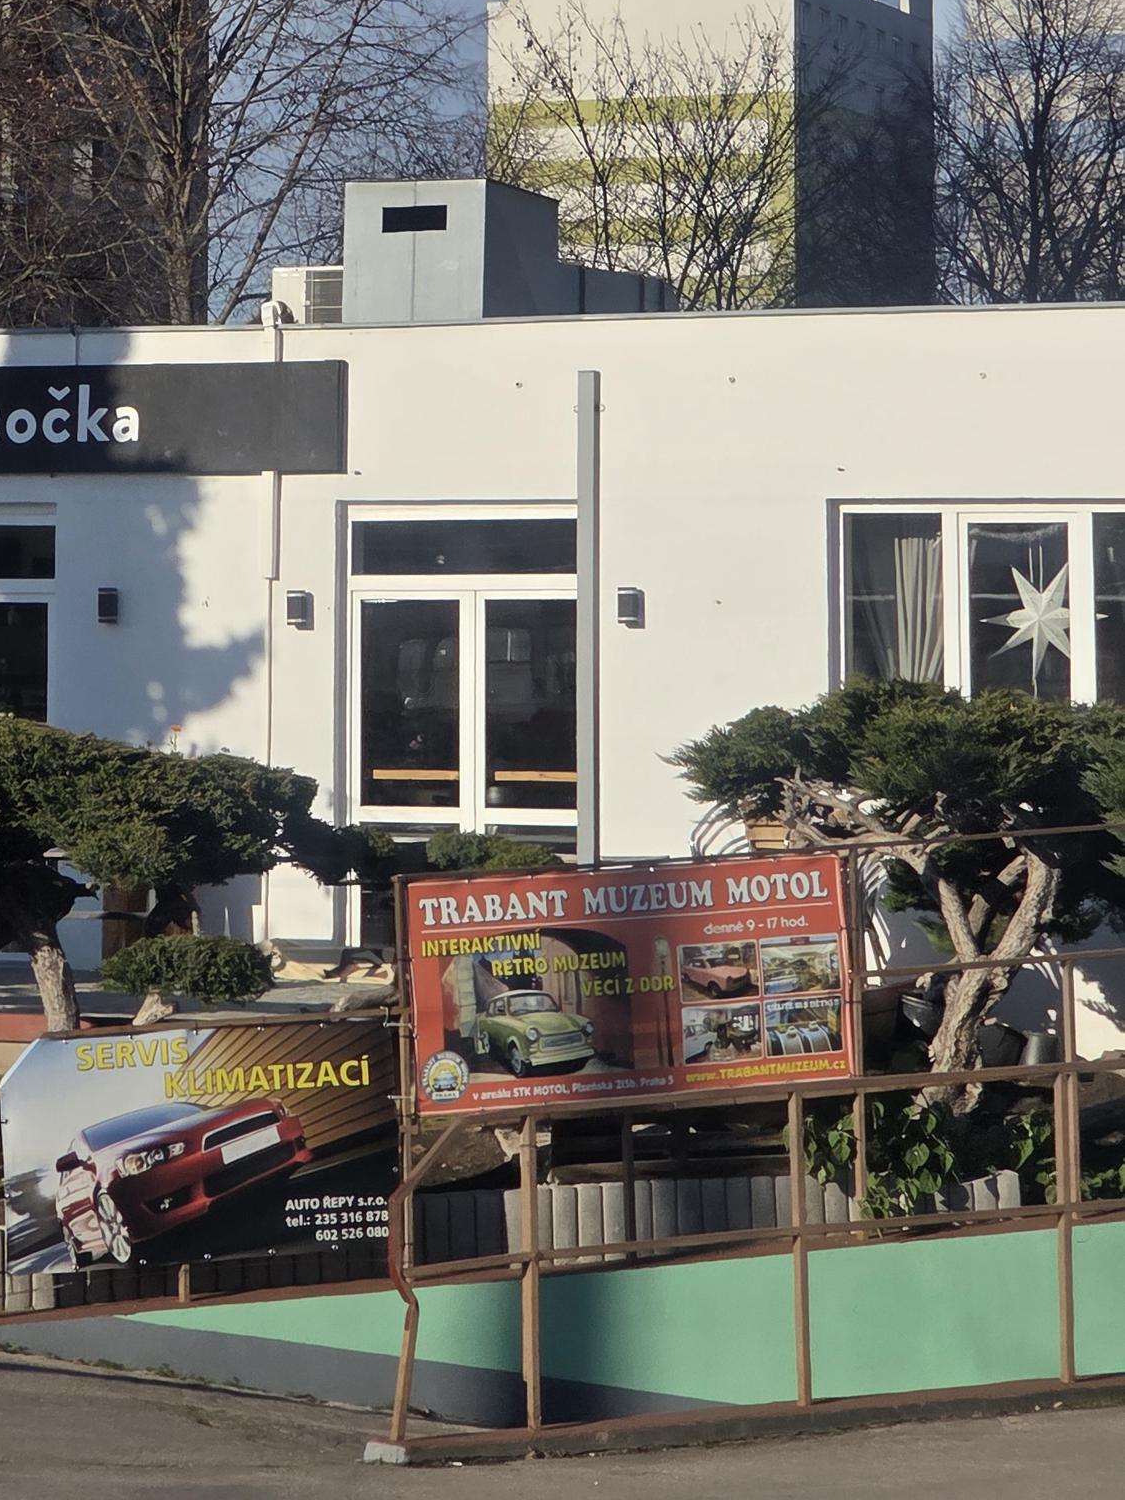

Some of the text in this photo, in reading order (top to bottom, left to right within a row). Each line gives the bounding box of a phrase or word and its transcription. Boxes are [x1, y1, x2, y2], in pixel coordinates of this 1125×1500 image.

[418, 870, 829, 927] TRABANT MUZEUM MOTOL
[746, 919, 755, 932] 9
[766, 916, 778, 929] 17
[780, 915, 809, 928] hod.
[421, 928, 541, 957] INTERAKTIVNÍ
[491, 951, 626, 977] RETRO MUZEUM
[581, 975, 675, 997] VĚCÍ Z DDR
[75, 1037, 189, 1071] SERVIS
[164, 1055, 371, 1098] KLIMATIZACÍ
[685, 1060, 846, 1083] www.TRABANTMUZEUM.cz
[472, 1092, 479, 1100] v
[481, 1088, 511, 1100] areálu
[513, 1086, 532, 1098] STK
[533, 1083, 571, 1097] MOTOL,
[640, 1076, 667, 1088] Praha
[668, 1075, 674, 1085] 5
[285, 1195, 388, 1211] AUTO ŘEPY s.r.o.
[285, 1210, 389, 1227] tel.: 235 316 878
[315, 1226, 389, 1241] 602 526 080
